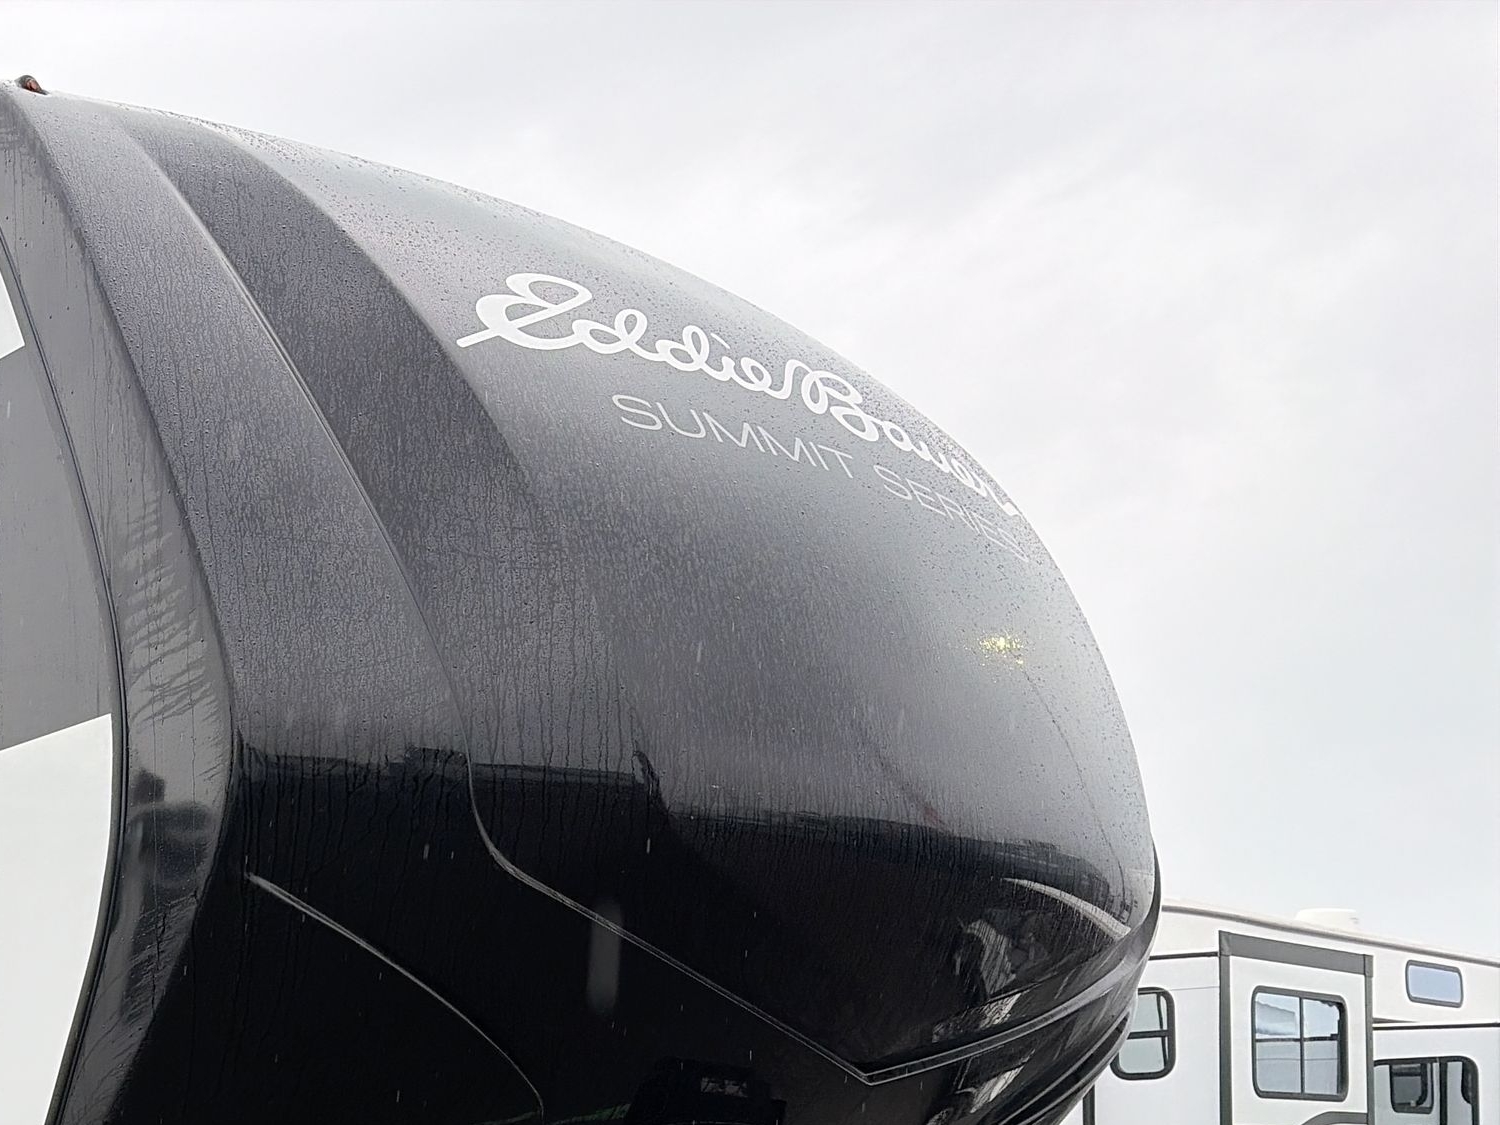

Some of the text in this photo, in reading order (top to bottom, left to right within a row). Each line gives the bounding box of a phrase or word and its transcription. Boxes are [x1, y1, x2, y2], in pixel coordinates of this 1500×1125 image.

[457, 272, 1022, 517] Eddie Bauer
[611, 393, 1030, 563] SUMMIT SERIES
